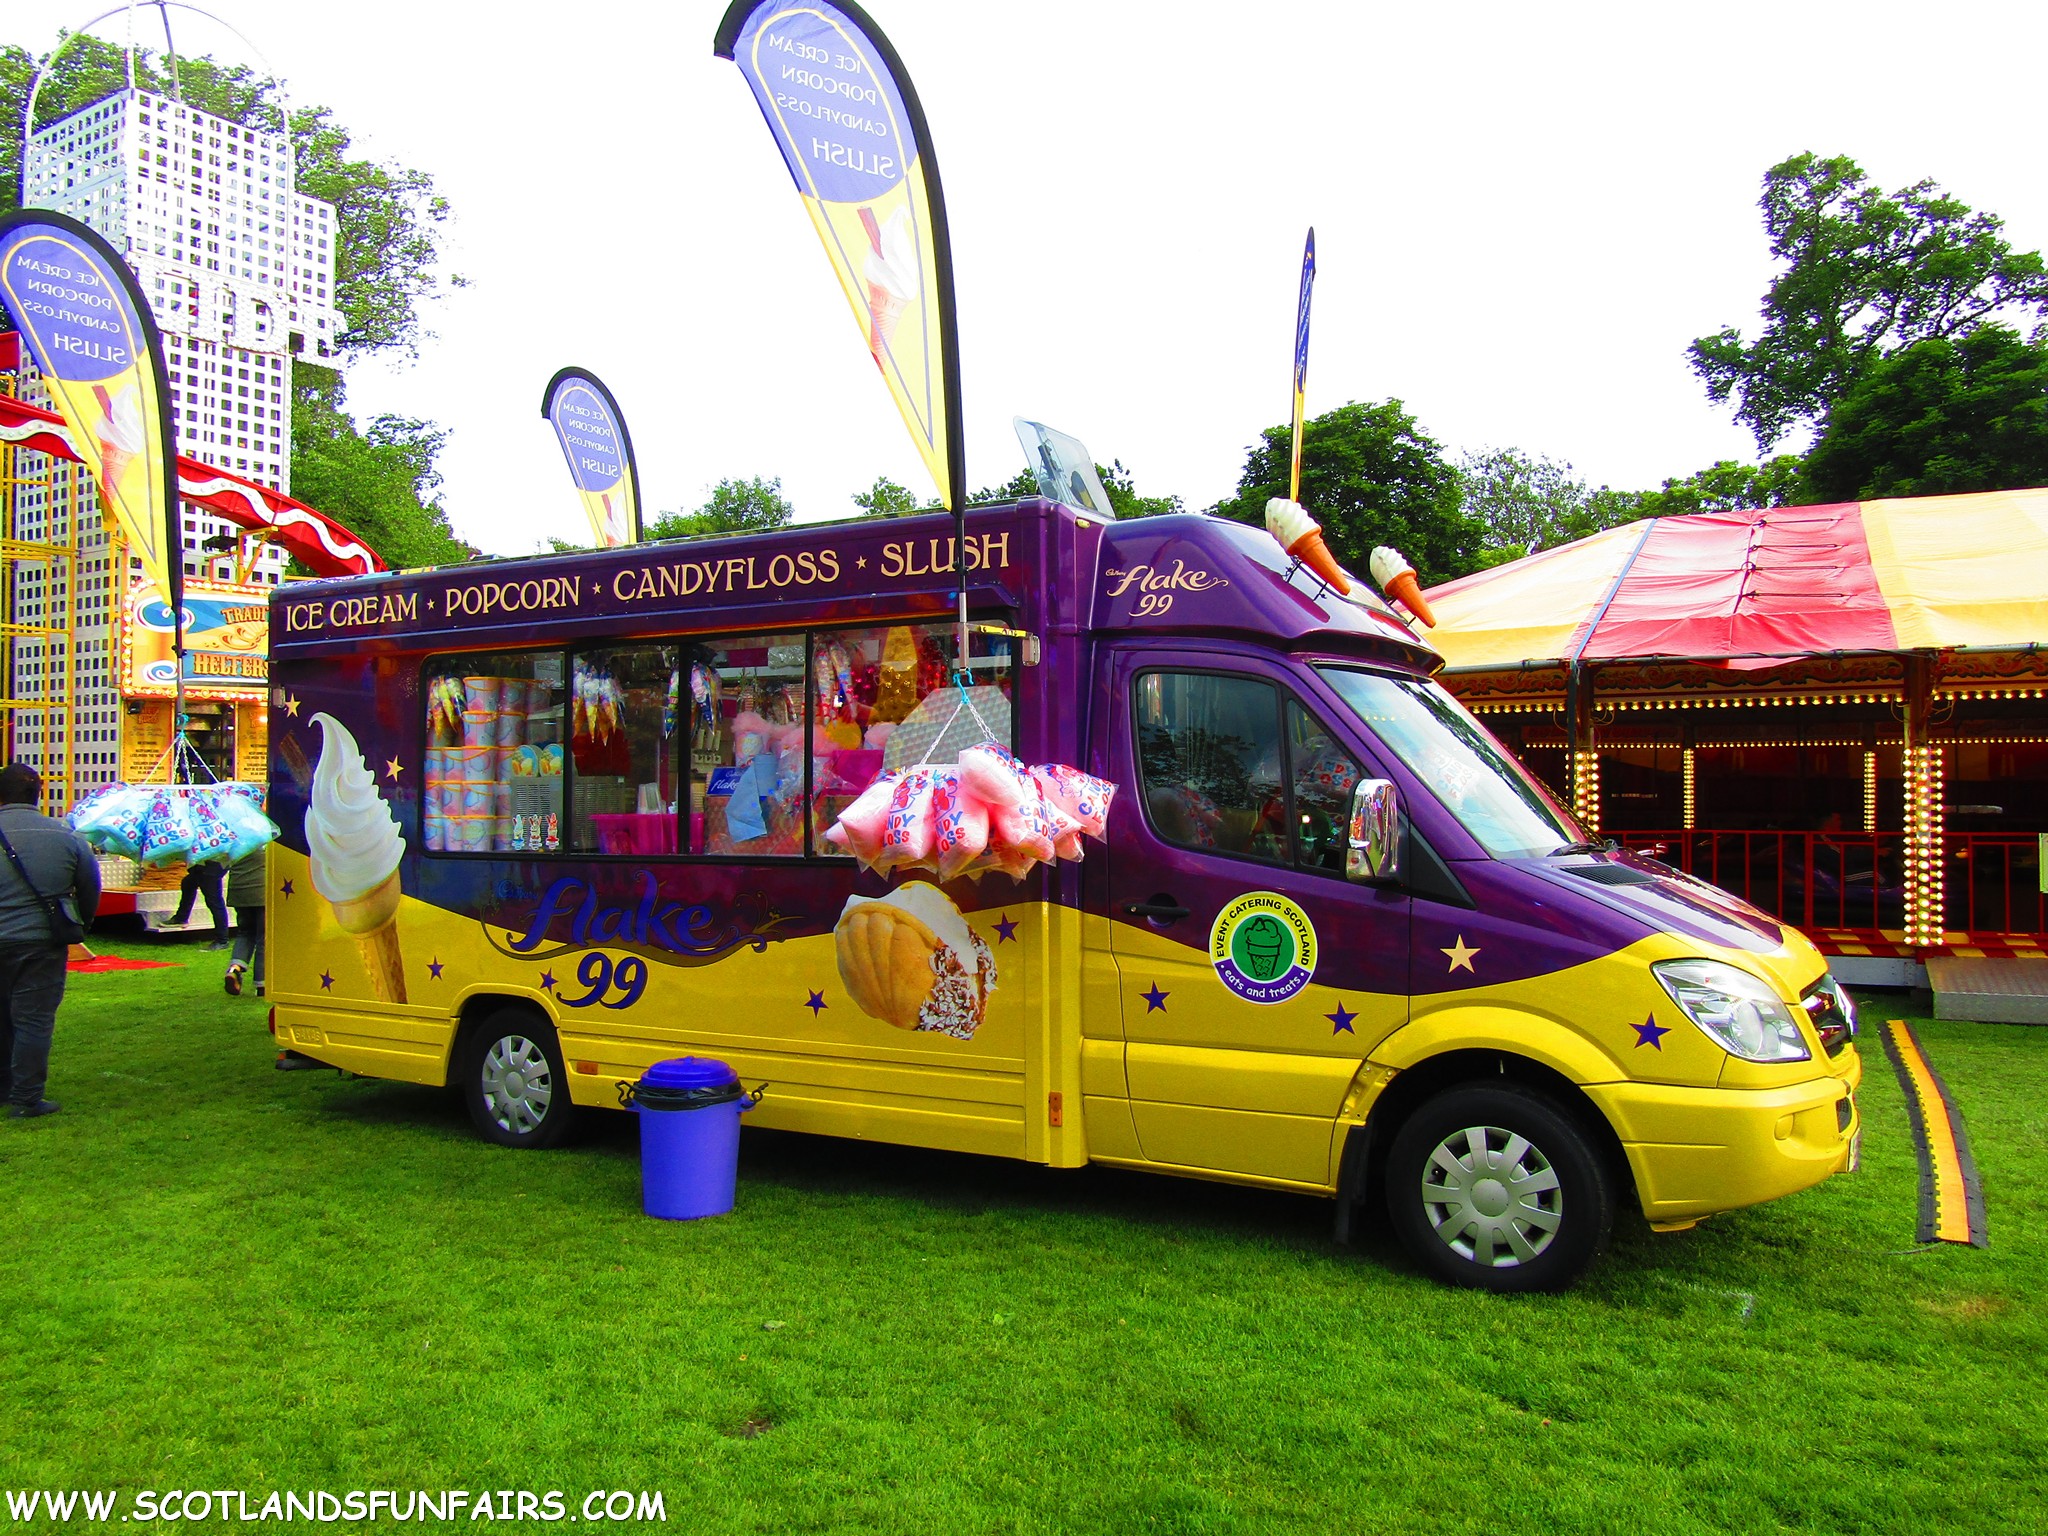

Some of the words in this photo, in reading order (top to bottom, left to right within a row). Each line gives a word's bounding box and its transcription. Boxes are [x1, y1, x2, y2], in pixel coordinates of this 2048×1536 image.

[285, 603, 325, 633] ICE
[329, 592, 418, 628] CREAM
[445, 575, 582, 617] POPCORN
[613, 549, 841, 602] CANDYFLOSS
[880, 532, 1010, 577] SLUSH
[1106, 559, 1229, 597] flake
[1128, 594, 1174, 617] 99
[149, 818, 182, 838] ANDY
[198, 820, 230, 840] ANDY
[887, 813, 916, 830] NDY
[935, 811, 964, 836] NDY
[884, 829, 911, 848] OSS
[937, 827, 966, 858] OSS
[506, 869, 767, 956] flake
[1216, 918, 1230, 958] EVENT
[1229, 898, 1282, 919] CATERING
[1283, 906, 1311, 966] SCOTLAND
[556, 952, 648, 1010] 99
[1224, 969, 1245, 990] eats
[1246, 988, 1266, 998] and
[1269, 975, 1301, 998] treats
